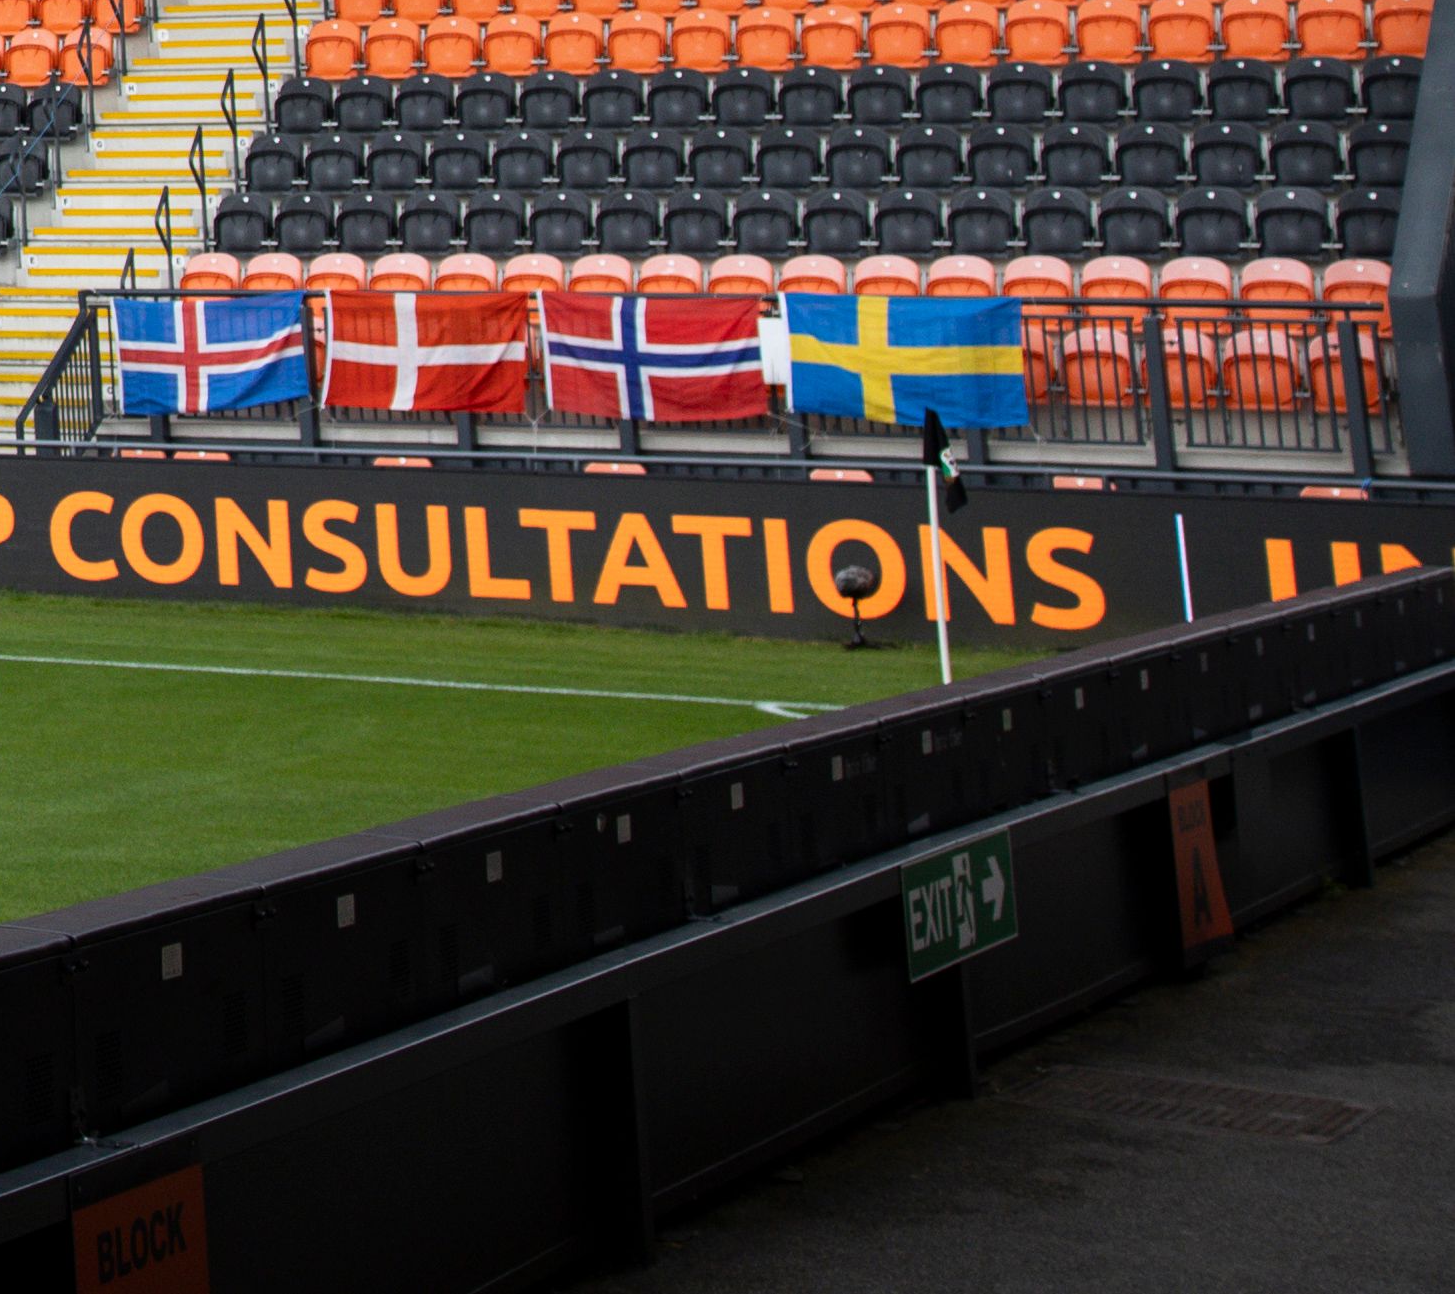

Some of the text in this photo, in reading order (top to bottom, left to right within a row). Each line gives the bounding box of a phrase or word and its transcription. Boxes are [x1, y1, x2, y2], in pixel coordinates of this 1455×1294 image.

[49, 491, 1107, 630] CONSULTATIONS
[907, 875, 954, 953] EXIT
[1192, 845, 1214, 927] A
[97, 1202, 187, 1285] BLOCK
